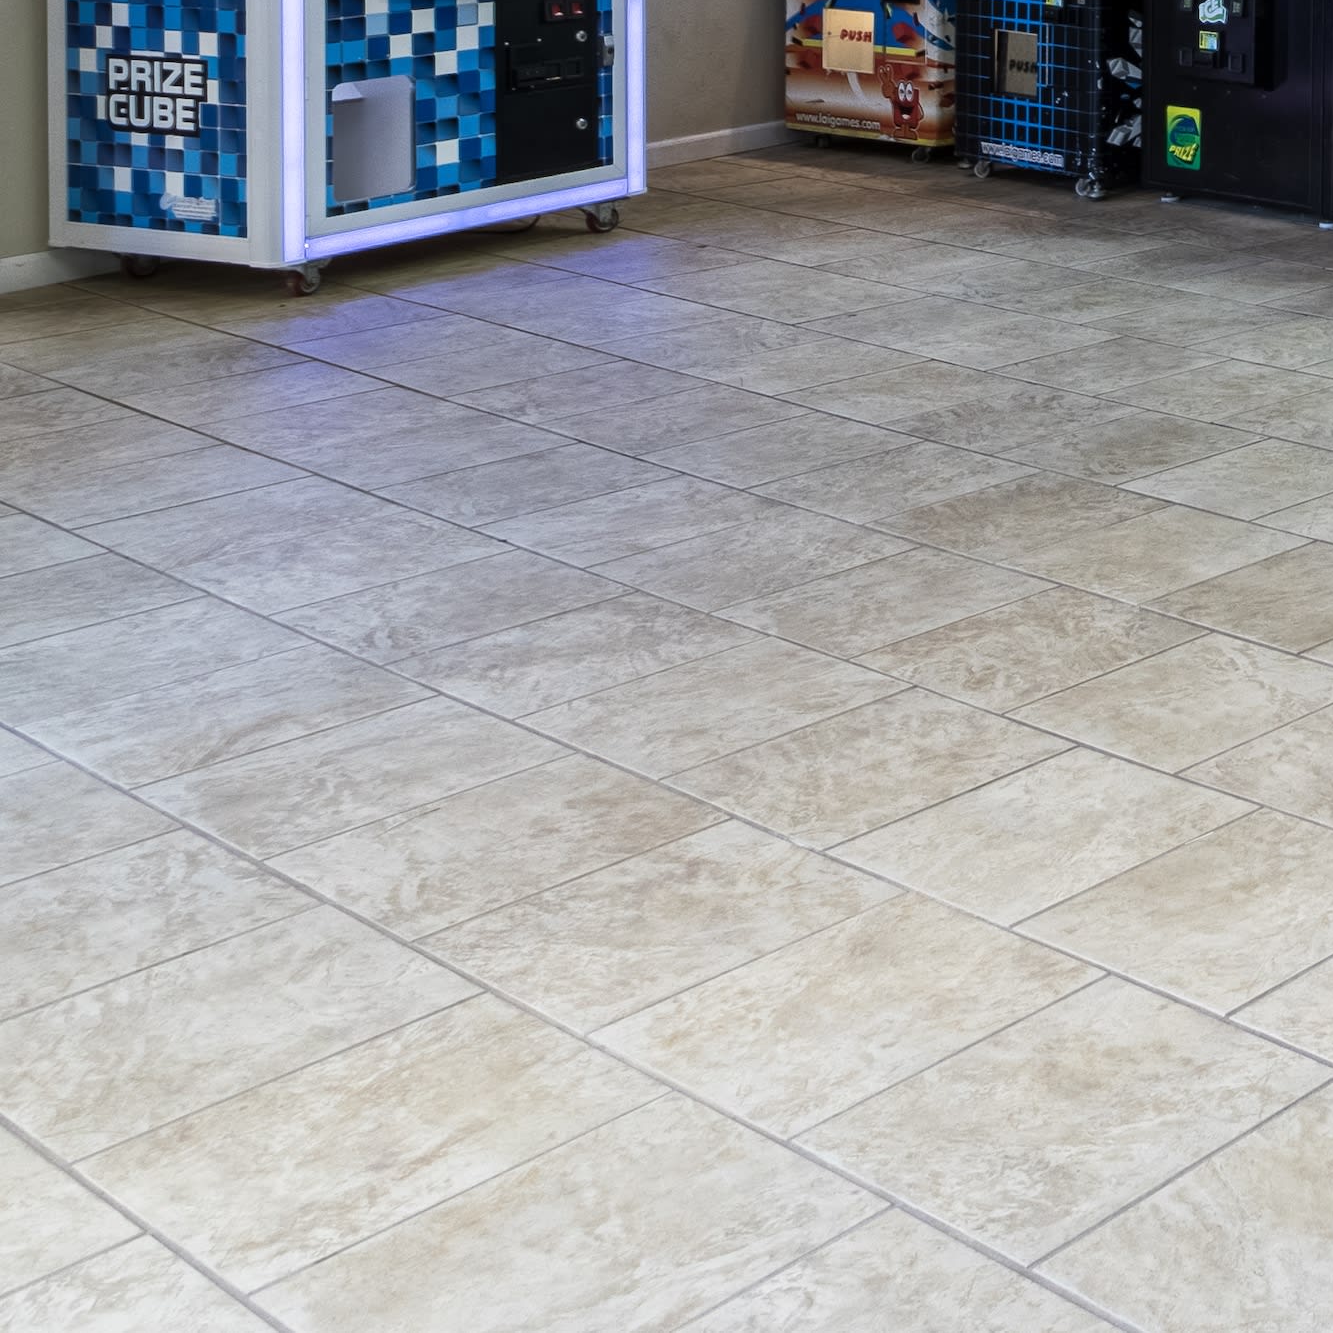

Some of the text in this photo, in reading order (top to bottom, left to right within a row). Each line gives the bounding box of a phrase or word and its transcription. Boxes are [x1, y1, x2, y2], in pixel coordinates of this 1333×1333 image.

[839, 29, 872, 43] PUSH
[1009, 58, 1036, 72] PUSH
[108, 58, 205, 96] PRIZE
[109, 94, 196, 131] CUBE
[795, 111, 881, 130] www.laigames.com
[981, 141, 1065, 168] www.laigames.com
[1168, 142, 1200, 163] PRIZE
